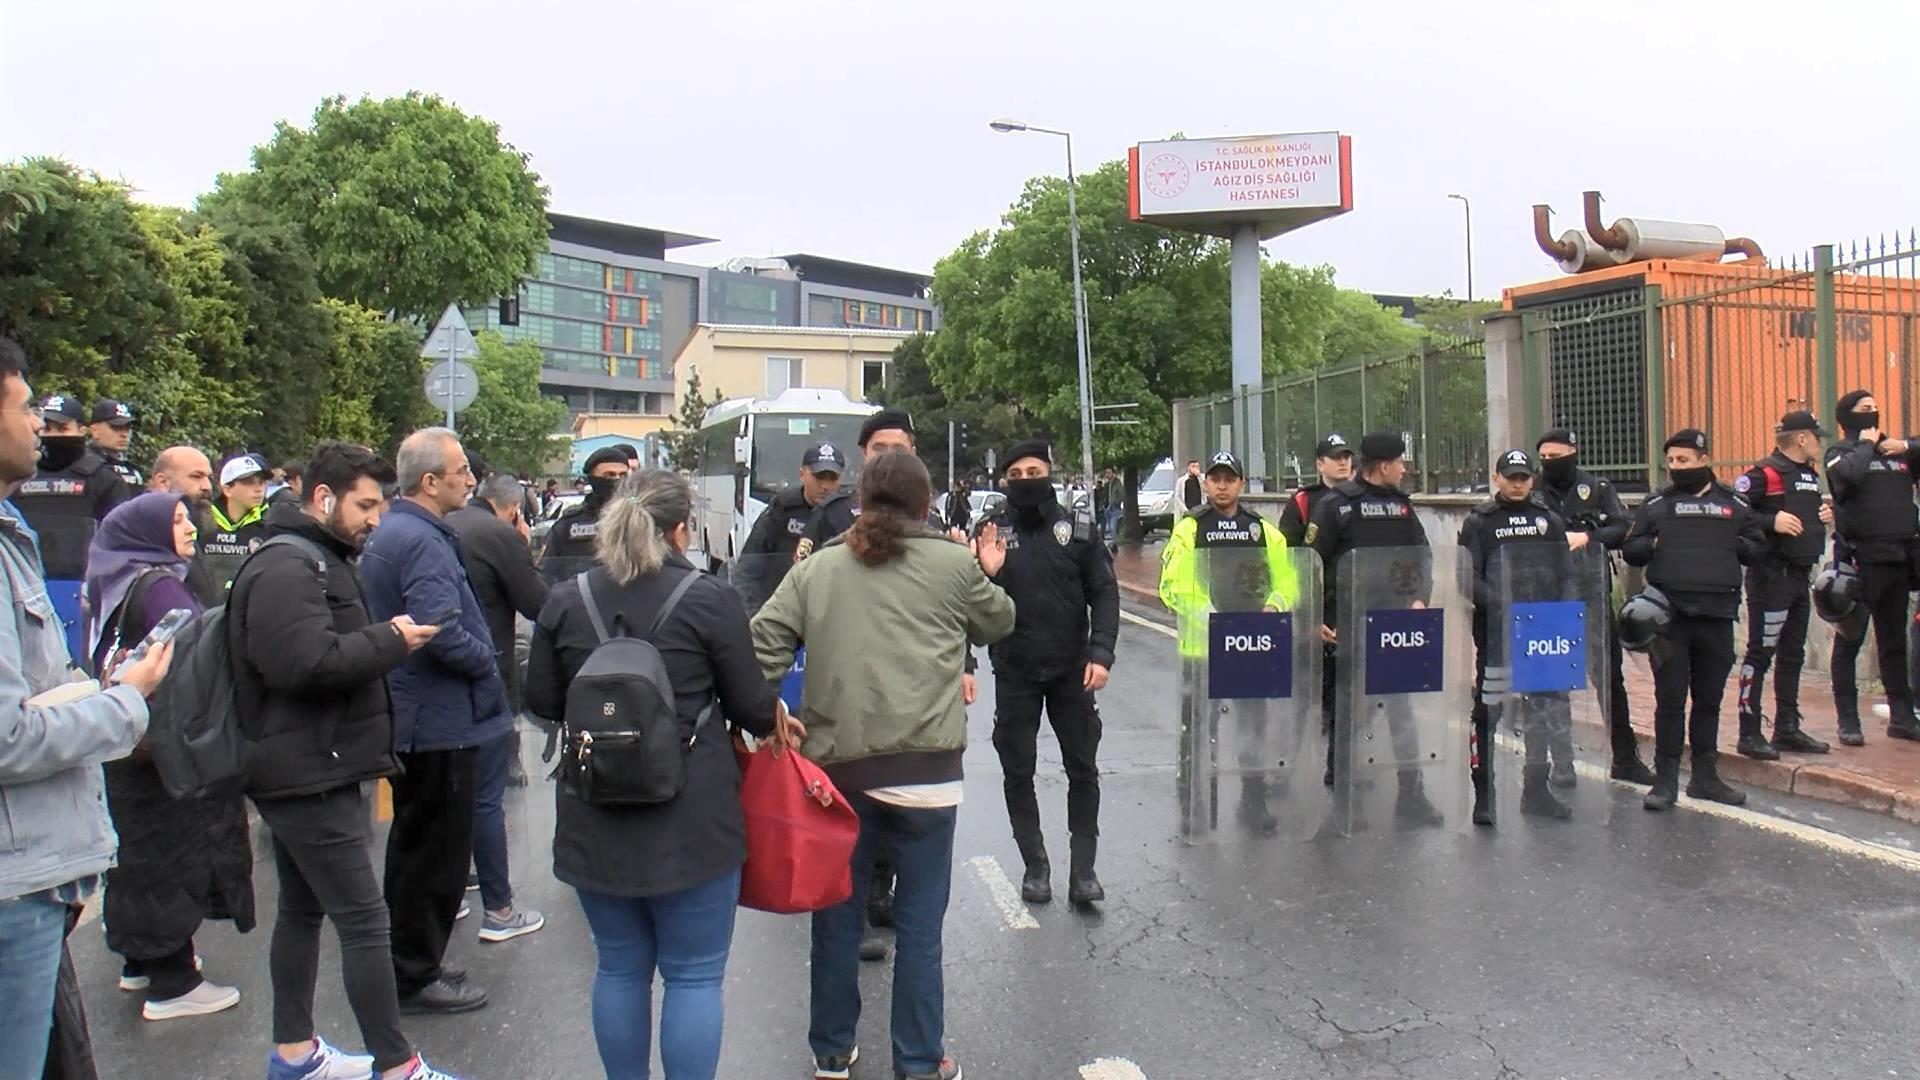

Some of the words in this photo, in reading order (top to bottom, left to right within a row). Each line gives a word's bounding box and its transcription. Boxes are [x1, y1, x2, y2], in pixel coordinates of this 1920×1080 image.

[1216, 147, 1229, 156] T.C.
[1231, 145, 1263, 155] SAĞLIK
[1265, 142, 1312, 153] BAKANLIĞI
[1196, 160, 1257, 172] İSTANBUL
[1258, 154, 1333, 169] OKMEYDANI
[1213, 175, 1242, 187] AĞIZ
[1244, 174, 1265, 187] DİŞ
[1266, 170, 1316, 185] SAĞLIĞI
[1230, 186, 1300, 202] HASTANESİ
[1225, 635, 1272, 651] POLİS
[1381, 631, 1424, 648] POLİS
[1528, 635, 1570, 656] POLİS
